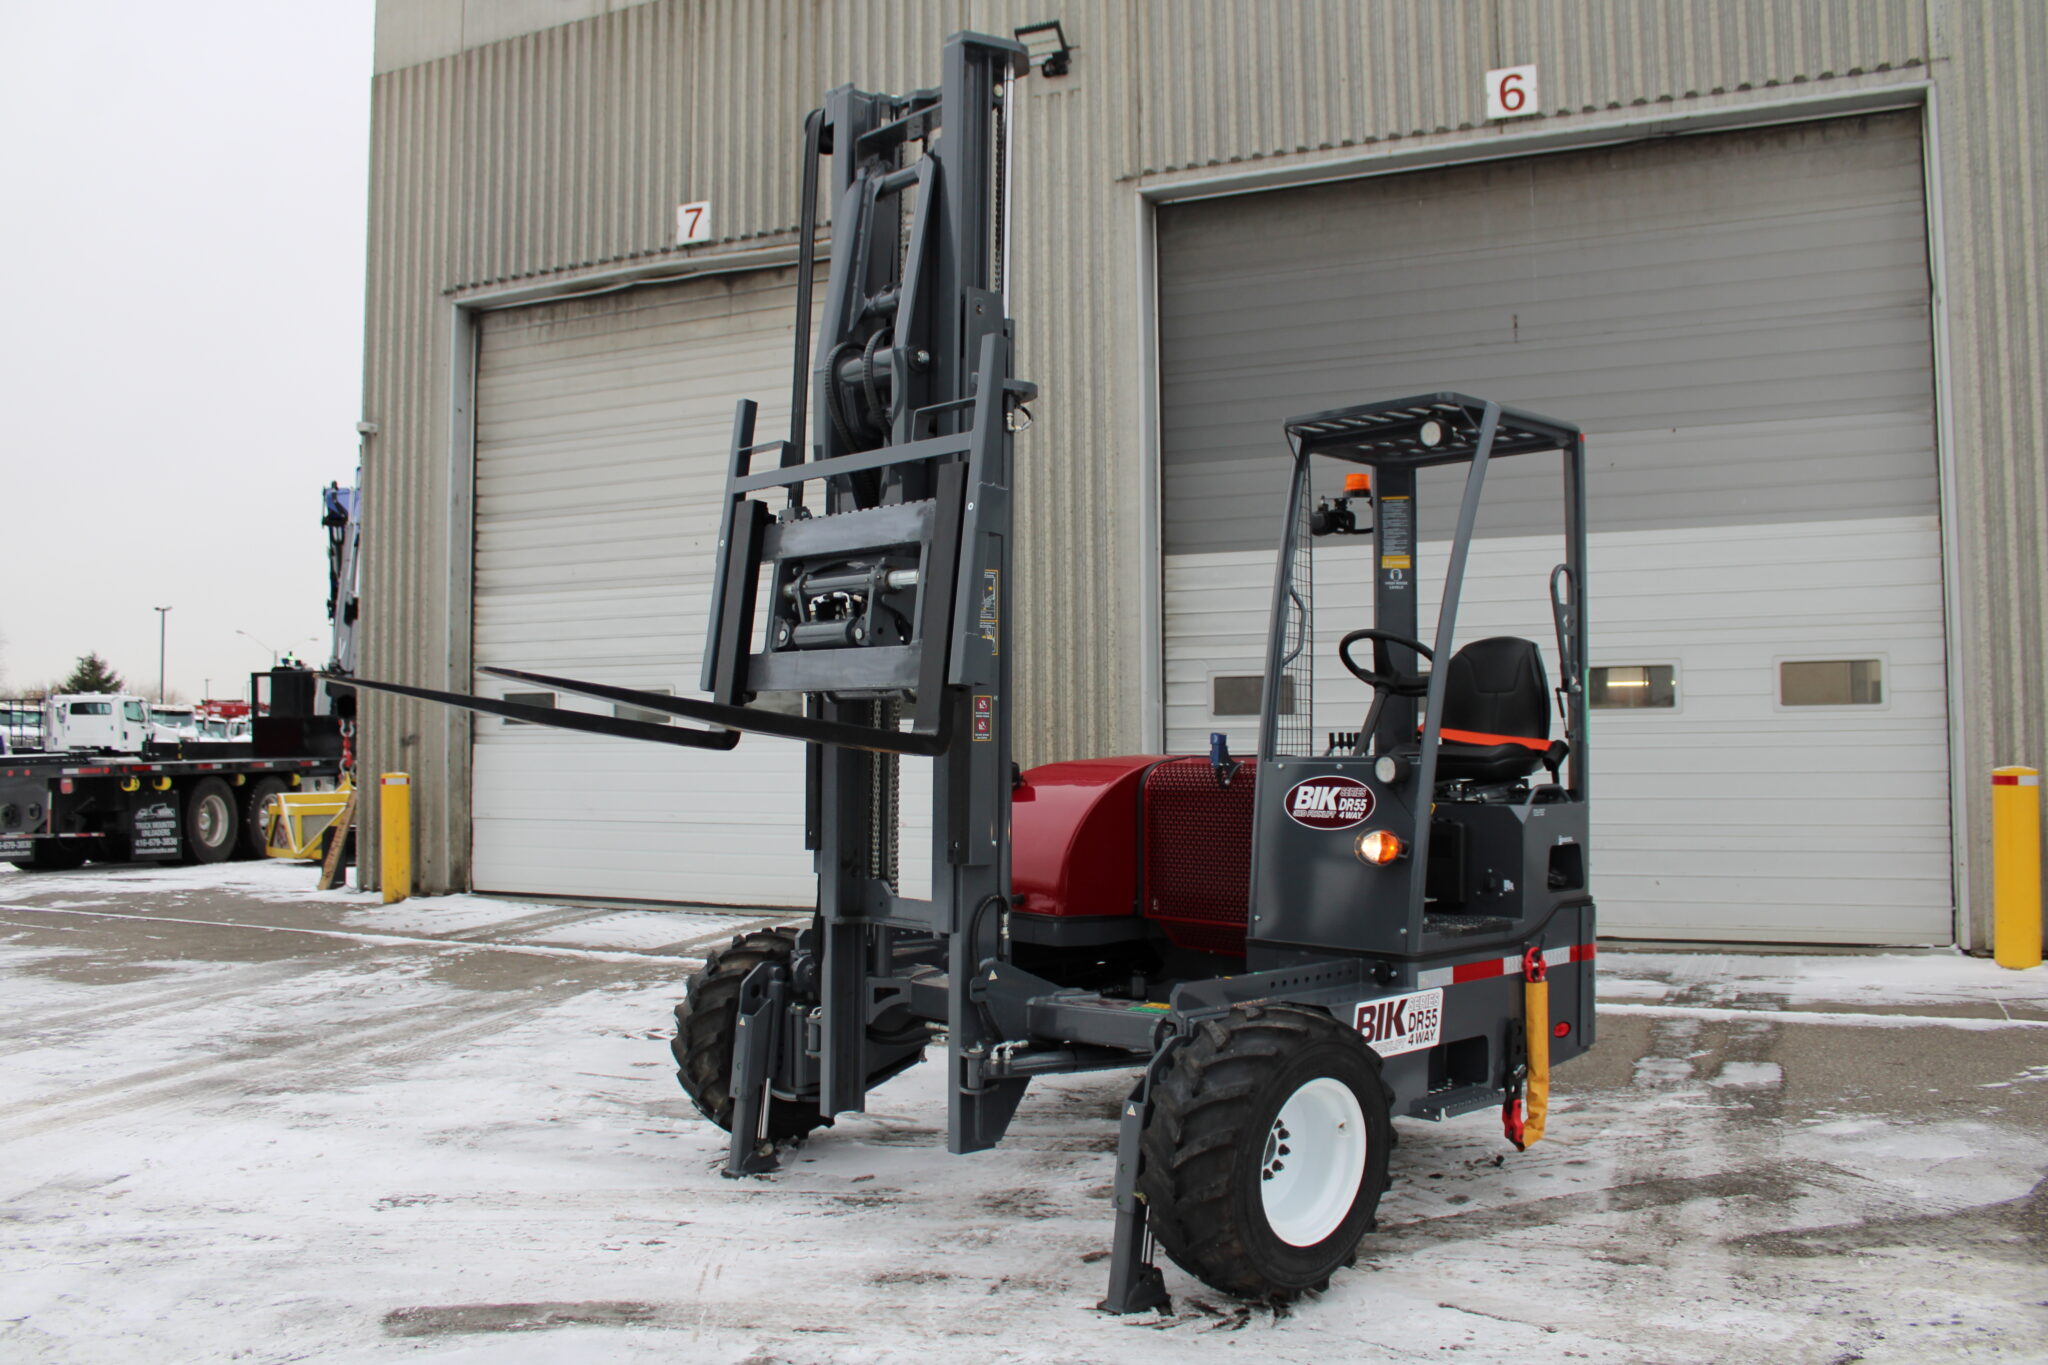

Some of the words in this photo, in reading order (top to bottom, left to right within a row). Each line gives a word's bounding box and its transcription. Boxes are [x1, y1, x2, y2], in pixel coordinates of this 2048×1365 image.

[1500, 73, 1525, 111] 6
[685, 207, 703, 238] 7
[1294, 785, 1341, 811] BIK
[1338, 798, 1367, 811] DR55
[1338, 811, 1345, 819] 4
[1357, 999, 1408, 1043] BIK
[1408, 1008, 1438, 1033] DR55
[1408, 1033, 1414, 1045] 4
